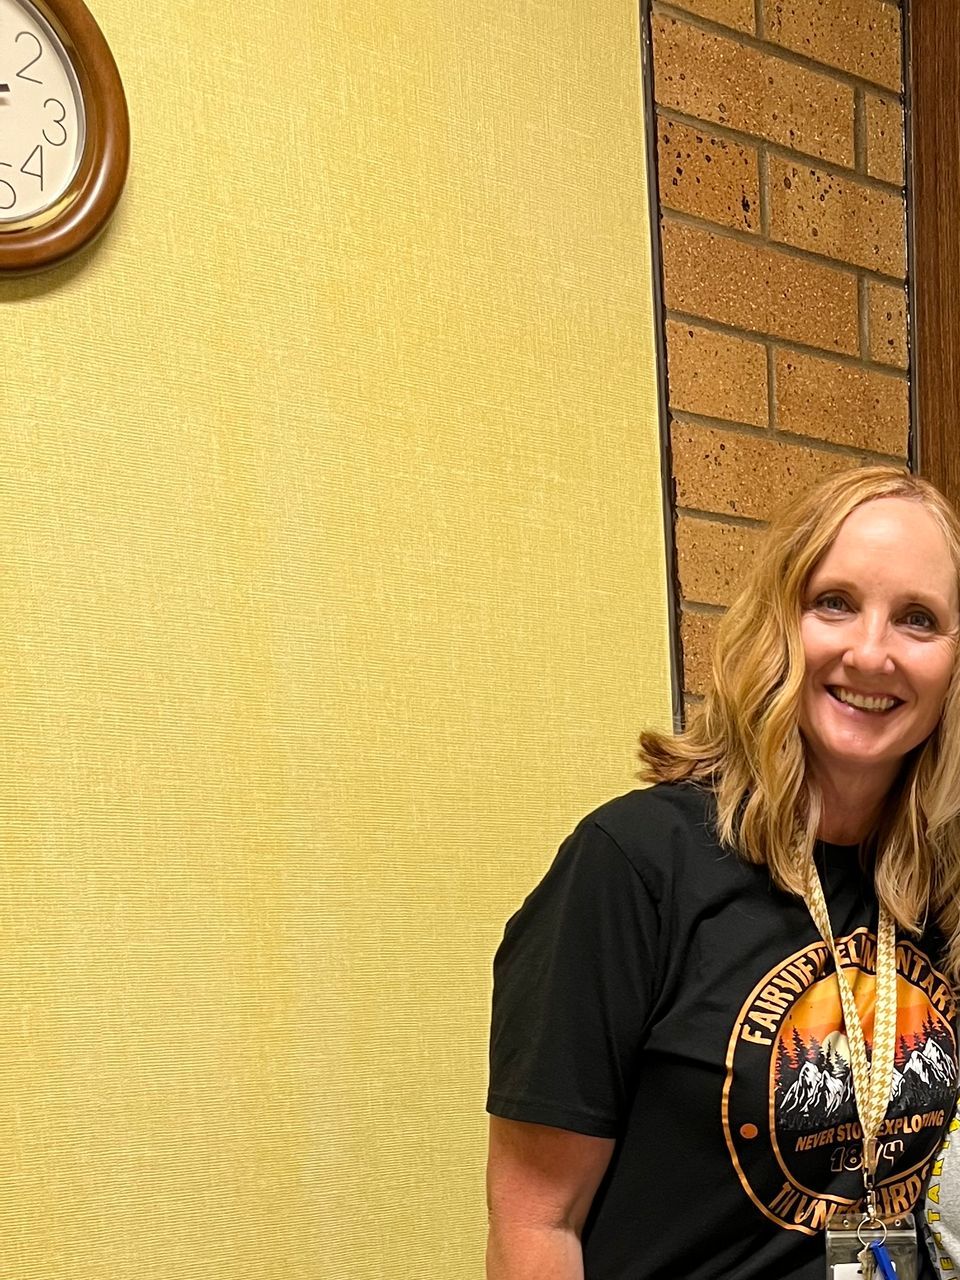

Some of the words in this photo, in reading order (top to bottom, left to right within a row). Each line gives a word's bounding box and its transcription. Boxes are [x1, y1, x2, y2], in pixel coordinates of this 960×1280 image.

[15, 31, 43, 84] 2
[42, 98, 67, 146] 3
[20, 144, 43, 191] 4
[795, 1127, 834, 1152] NEVER
[837, 1122, 862, 1141] STO
